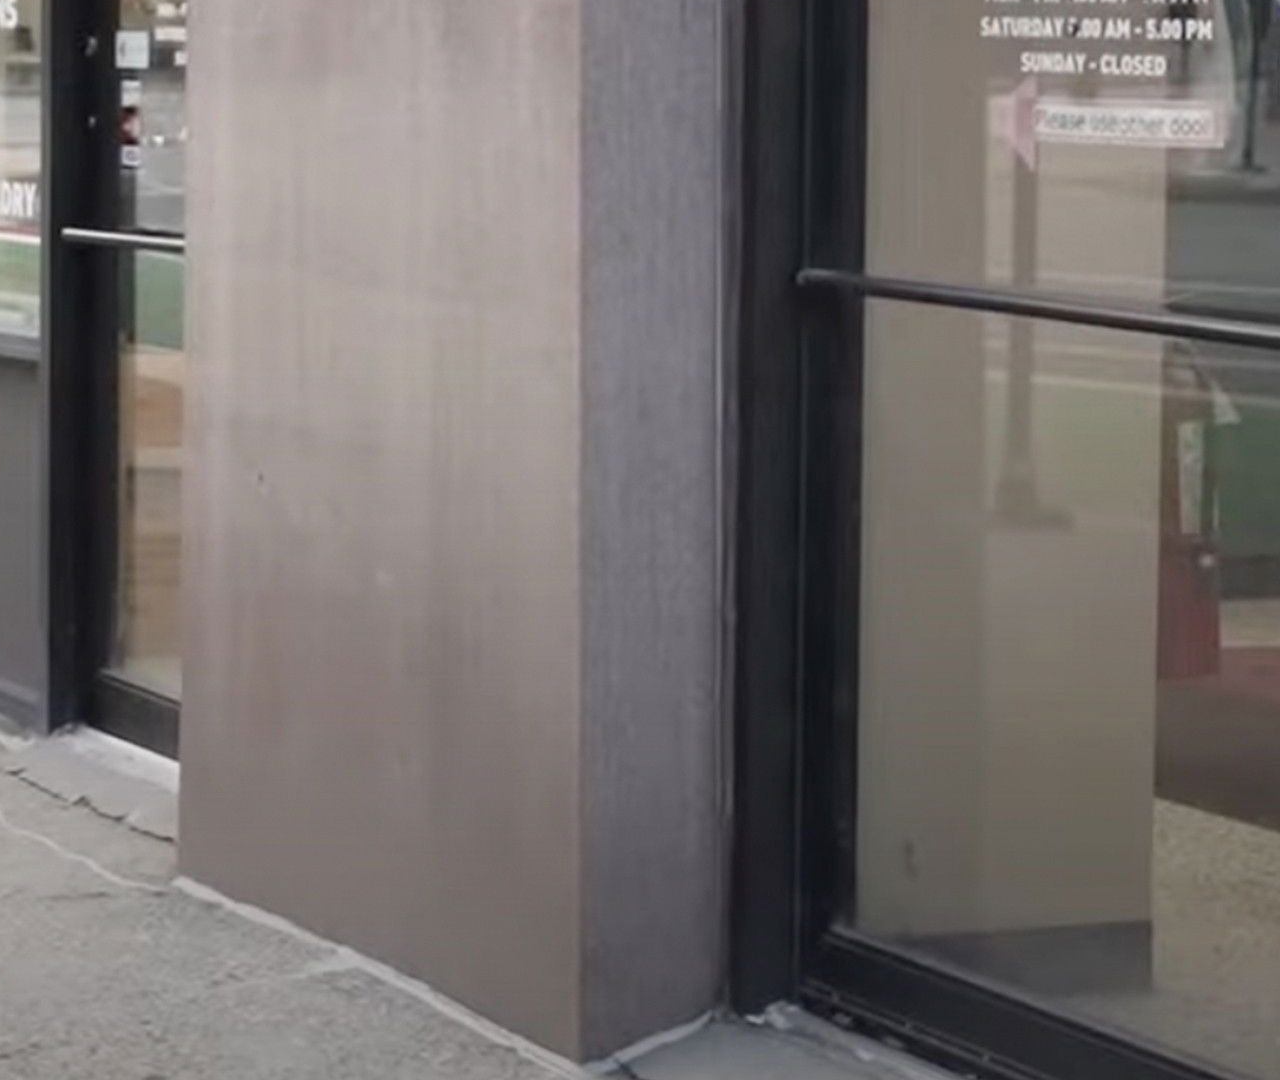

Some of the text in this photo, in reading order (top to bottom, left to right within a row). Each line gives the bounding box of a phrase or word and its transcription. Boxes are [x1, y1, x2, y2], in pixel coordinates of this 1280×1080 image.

[980, 16, 1065, 39] SATURDAY
[1103, 18, 1131, 40] AM
[1185, 19, 1213, 41] PM
[1020, 52, 1087, 73] SUNDAY
[1100, 54, 1167, 76] CLOSED
